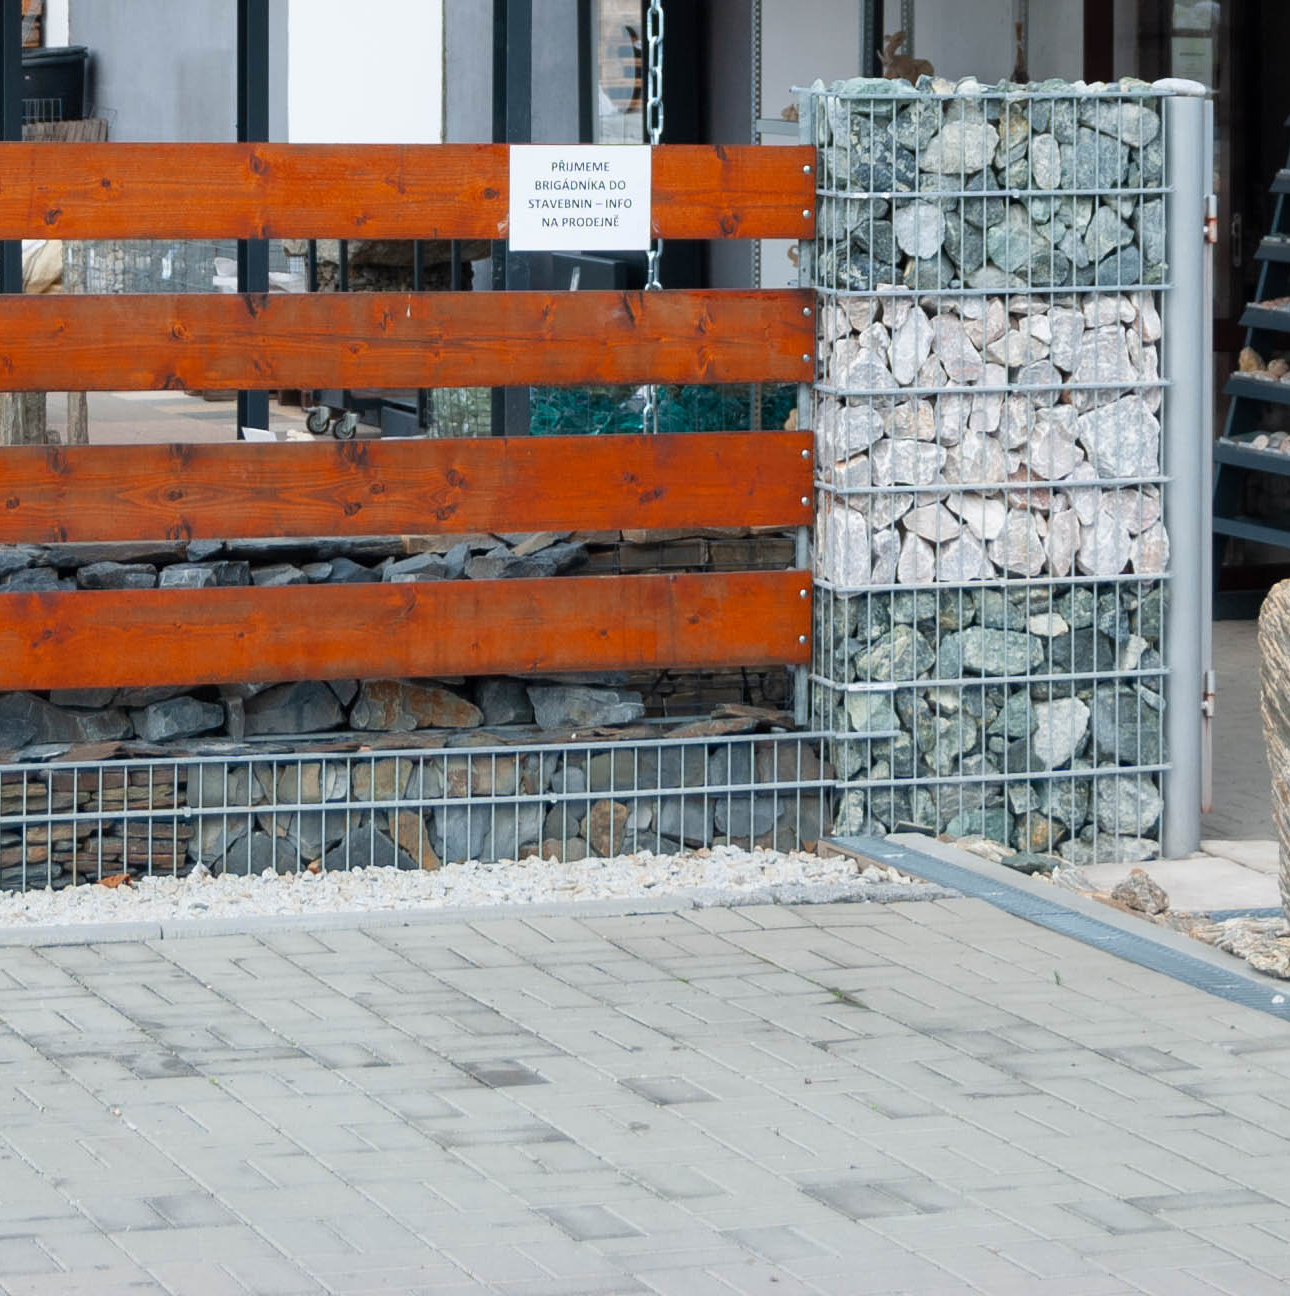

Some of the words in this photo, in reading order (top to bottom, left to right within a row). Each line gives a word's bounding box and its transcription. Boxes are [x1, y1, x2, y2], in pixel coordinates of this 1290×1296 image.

[551, 160, 610, 172] PŘIJMEME
[534, 178, 606, 191] BRIGÁDNÍKA
[609, 180, 626, 191] DO
[528, 198, 592, 209] STAVEBNIN
[605, 198, 633, 209] INFO
[541, 217, 558, 228] NA
[562, 214, 620, 228] PRODEJNĚ
